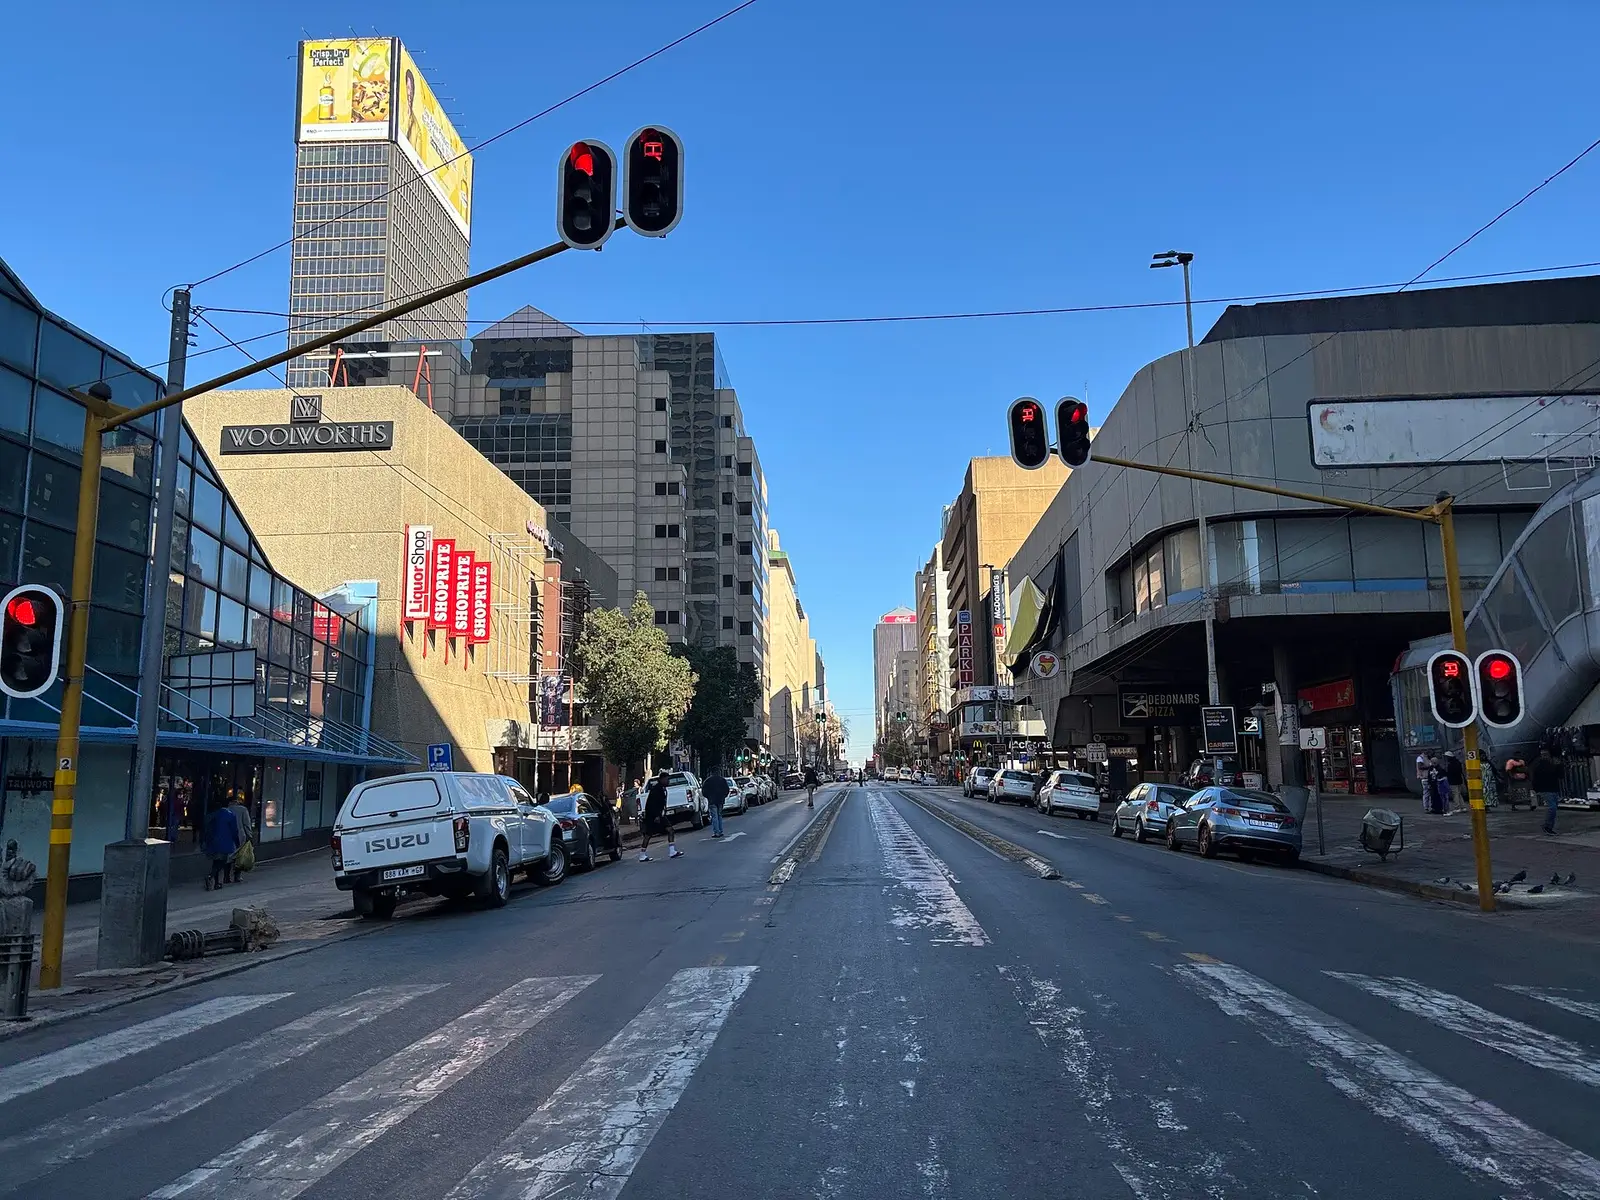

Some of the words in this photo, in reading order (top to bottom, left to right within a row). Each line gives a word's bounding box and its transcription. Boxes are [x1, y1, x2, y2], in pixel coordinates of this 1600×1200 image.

[311, 50, 332, 59] Crisp.
[333, 49, 348, 58] Dry.
[314, 58, 344, 66] Perfect.
[228, 424, 387, 447] WOOLWORTHS
[434, 544, 451, 622] SHOPRITE
[455, 556, 471, 630] SHOPRITE
[993, 575, 1001, 619] McDonald's
[473, 566, 488, 637] SHOPRITE
[1148, 693, 1200, 705] DEBONAIRS
[1148, 706, 1176, 717] PIZZA
[433, 747, 445, 762] P
[1469, 751, 1475, 760] 3
[61, 758, 70, 770] 2
[365, 833, 430, 853] ISUZU
